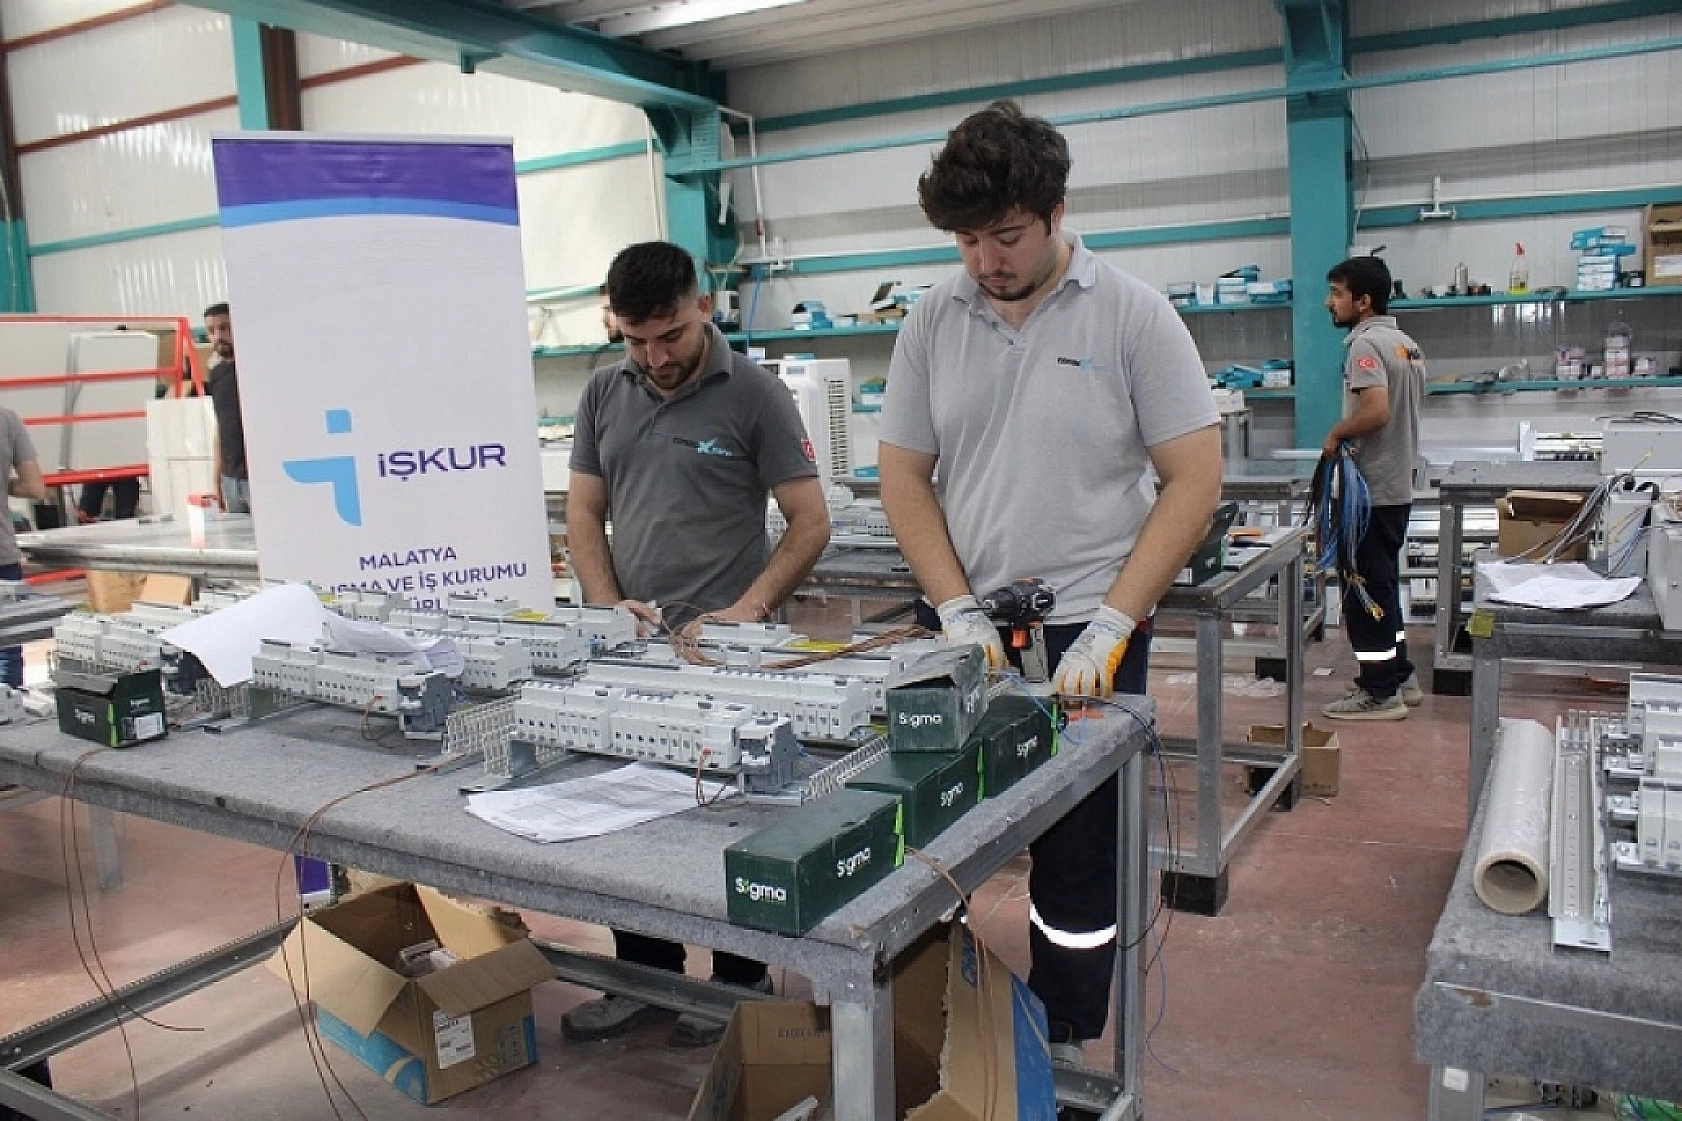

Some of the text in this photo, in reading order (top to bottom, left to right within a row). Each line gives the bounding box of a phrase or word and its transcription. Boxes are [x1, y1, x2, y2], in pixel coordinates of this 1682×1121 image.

[359, 546, 457, 571] MALATYA
[387, 576, 414, 592] VE
[418, 570, 439, 594] İŞ
[442, 563, 528, 588] KURUMU
[940, 782, 964, 806] Sgma
[837, 846, 871, 878] Sgma
